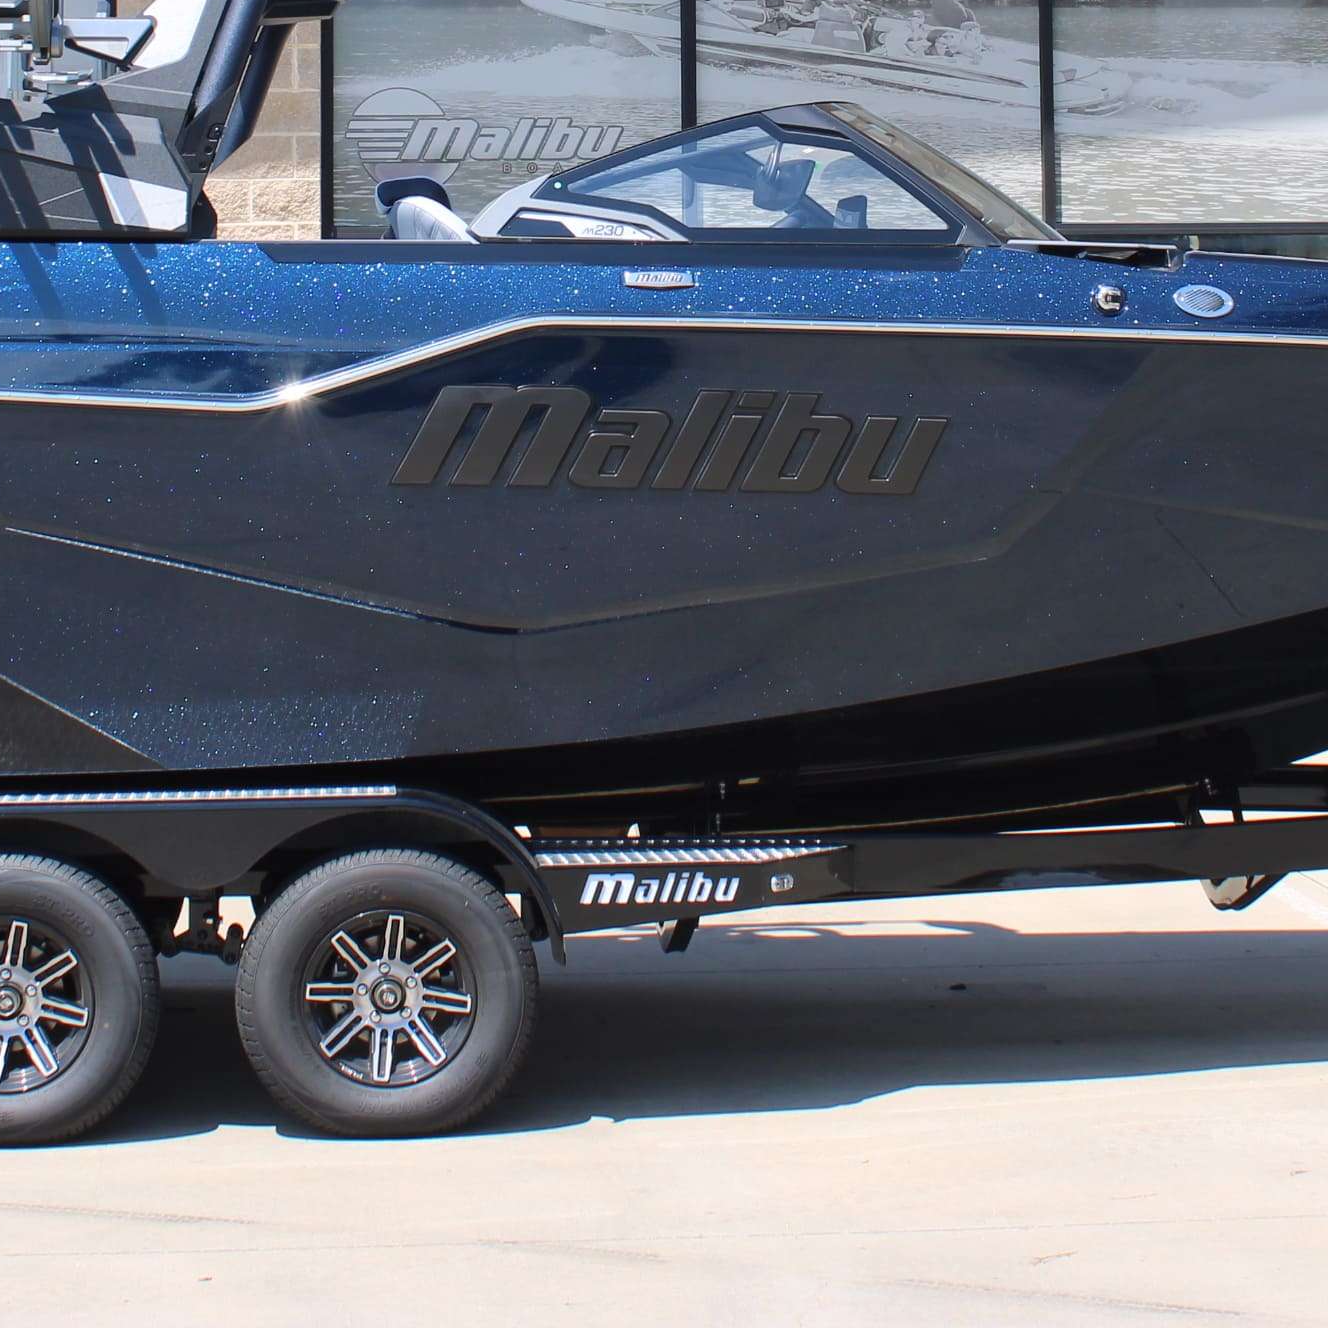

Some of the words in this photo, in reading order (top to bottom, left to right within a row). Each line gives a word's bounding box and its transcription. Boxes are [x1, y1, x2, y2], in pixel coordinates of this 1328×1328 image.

[400, 117, 623, 160] Malibu
[389, 384, 950, 494] Malibu
[579, 872, 740, 905] Malibu
